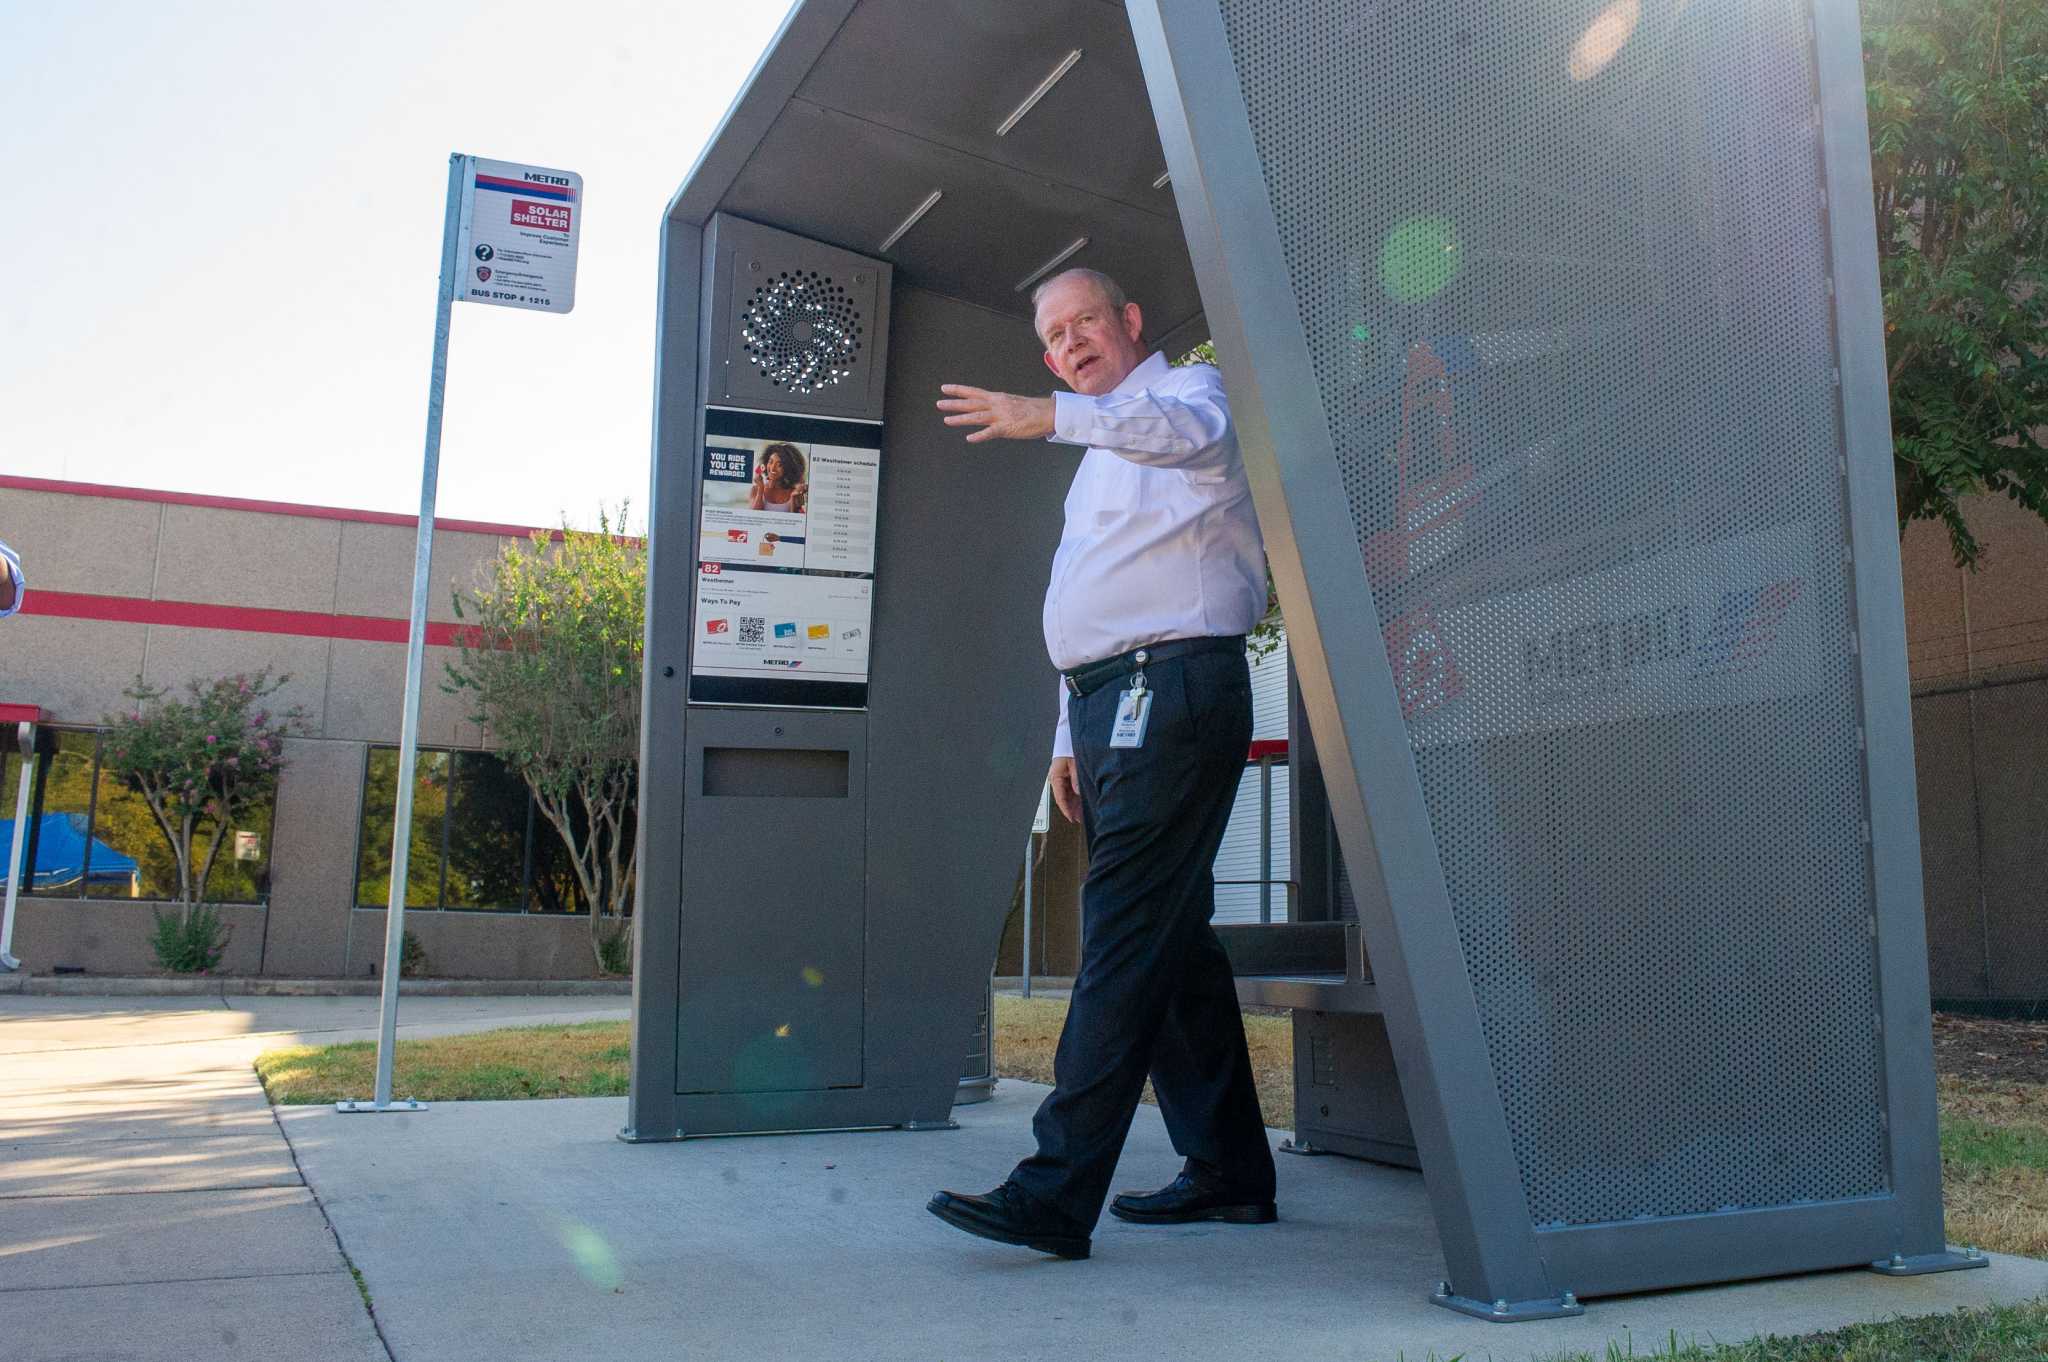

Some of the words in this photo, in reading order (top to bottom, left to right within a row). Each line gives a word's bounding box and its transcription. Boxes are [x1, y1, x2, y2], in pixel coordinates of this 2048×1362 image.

[524, 172, 569, 187] METRO
[528, 205, 569, 219] SOLAR
[513, 213, 568, 228] SHELTER
[471, 288, 490, 298] BUS
[493, 291, 517, 301] STOP
[710, 452, 726, 460] YOU
[728, 454, 746, 463] RIDE
[710, 460, 727, 469] YOU
[729, 462, 746, 471] GET
[704, 564, 719, 574] 82
[701, 597, 719, 605] Ways
[729, 599, 741, 607] Pay
